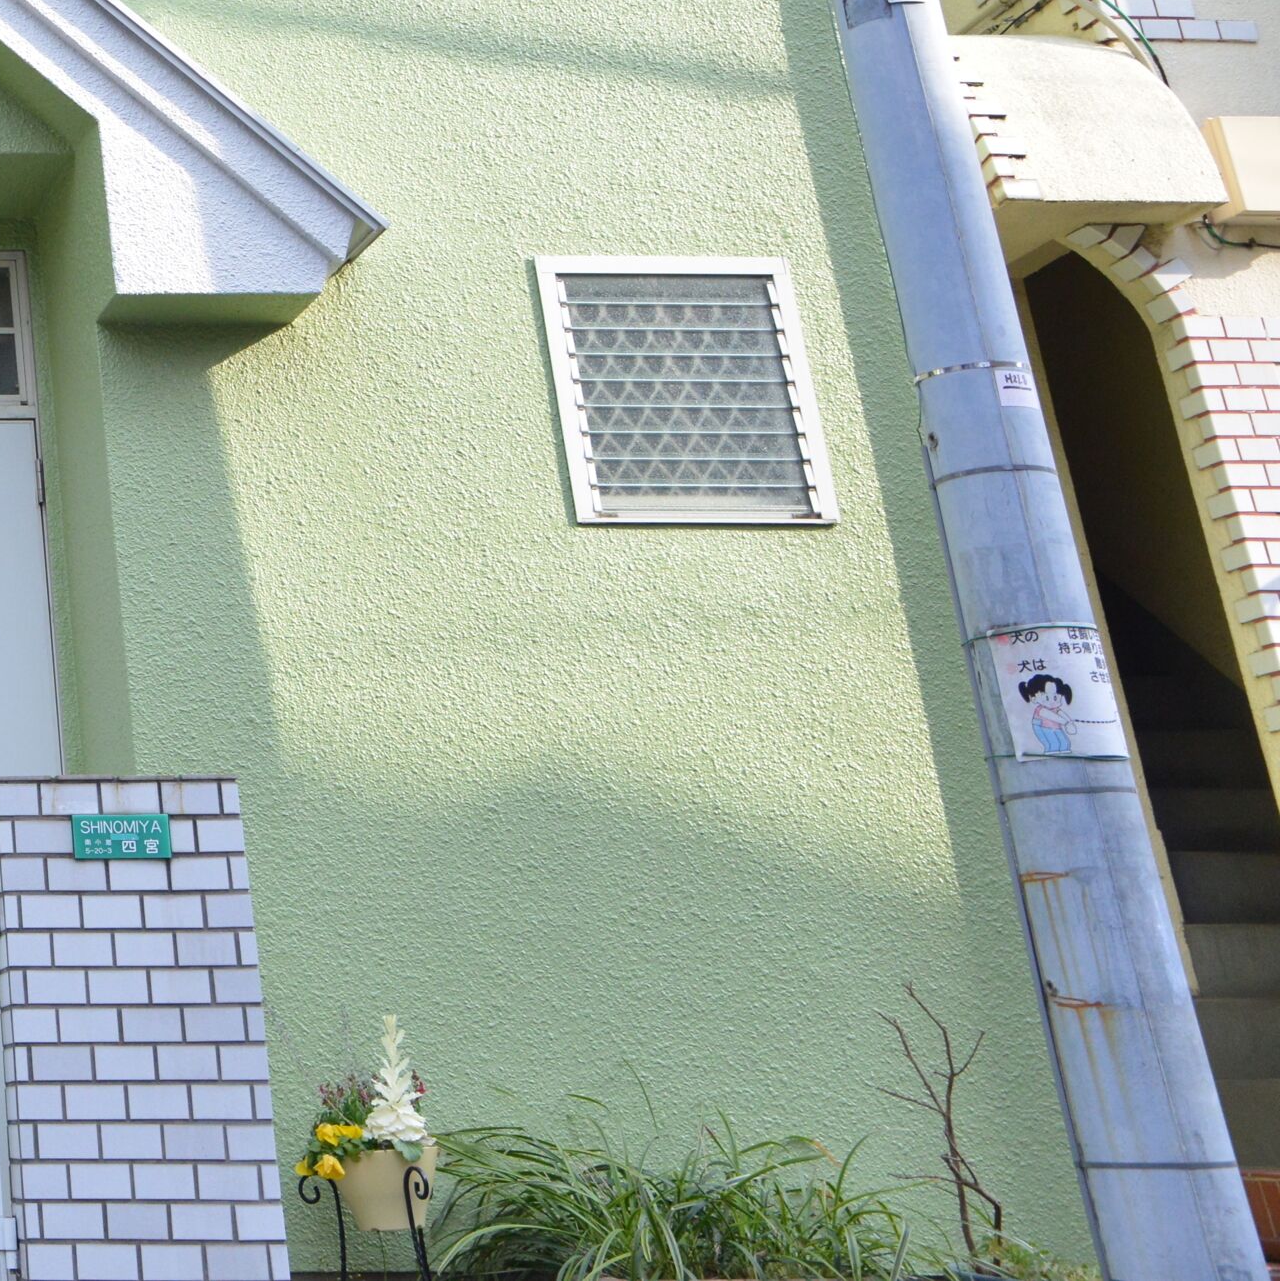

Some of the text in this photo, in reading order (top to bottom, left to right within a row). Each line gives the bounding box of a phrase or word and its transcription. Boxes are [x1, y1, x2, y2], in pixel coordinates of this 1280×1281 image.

[1010, 630, 1039, 645] 犬の
[1017, 658, 1047, 673] 犬は
[80, 820, 162, 834] SHINOMIYA
[84, 847, 113, 855] 5-20-3
[121, 838, 159, 854] 四宮
